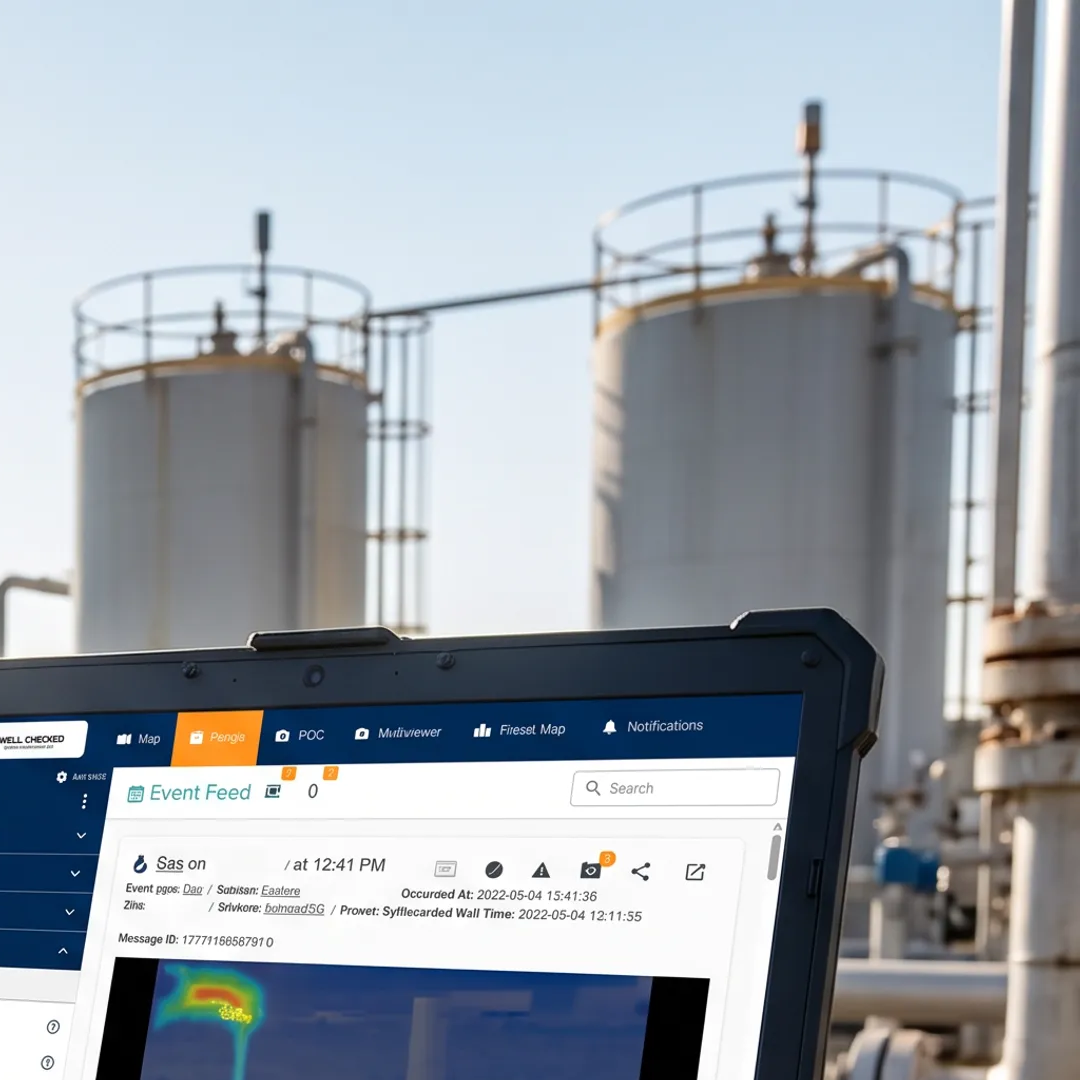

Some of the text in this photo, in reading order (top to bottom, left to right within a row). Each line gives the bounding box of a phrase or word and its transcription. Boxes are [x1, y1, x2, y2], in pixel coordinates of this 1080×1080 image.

[540, 723, 566, 737] Map
[627, 720, 704, 733] Notifications
[138, 734, 161, 746] Map
[298, 729, 325, 741] POC
[150, 783, 252, 801] Event Feed
[609, 782, 654, 795] Search
[157, 855, 184, 871] Sas
[188, 859, 206, 871] on
[293, 858, 309, 871] at
[313, 857, 354, 872] 12:41
[359, 858, 386, 872] PM
[125, 882, 154, 893] Event
[457, 889, 474, 900] At:
[477, 889, 543, 901] 2022-05-04
[547, 890, 598, 902] 15:41:36
[456, 908, 480, 918] Wall
[483, 908, 515, 919] Time:
[518, 909, 586, 921] 2022-05-04
[590, 910, 643, 923] 12:11:55
[118, 932, 163, 947] Message
[165, 934, 179, 945] ID:
